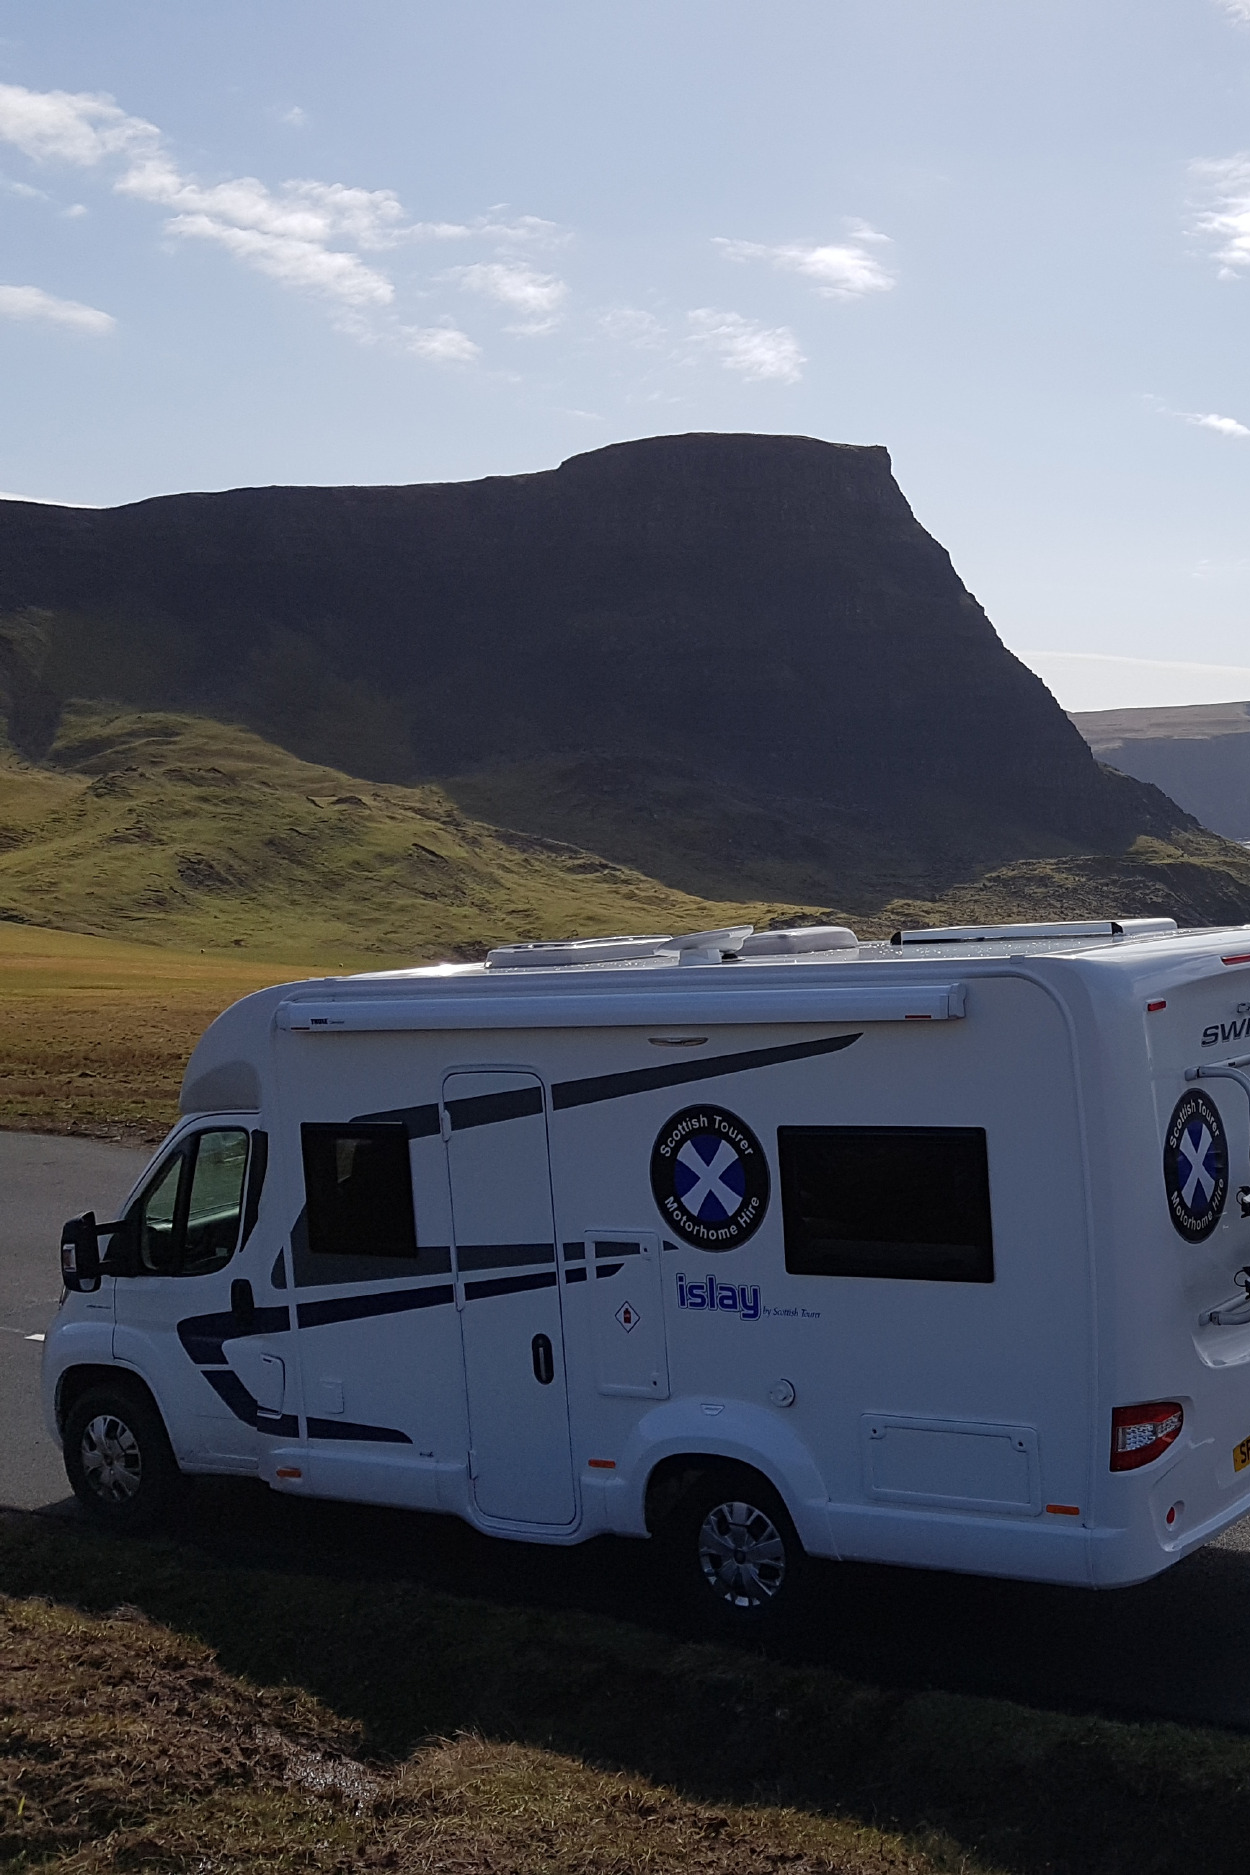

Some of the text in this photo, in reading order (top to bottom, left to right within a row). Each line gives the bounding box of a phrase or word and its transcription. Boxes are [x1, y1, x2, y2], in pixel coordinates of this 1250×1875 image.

[660, 1114, 754, 1157] Scottish Tourer
[1169, 1099, 1220, 1149] Scottish Tourer
[664, 1196, 760, 1240] Motorhome Hire
[1171, 1178, 1224, 1231] Motorhome Hire
[676, 1273, 761, 1321] islay
